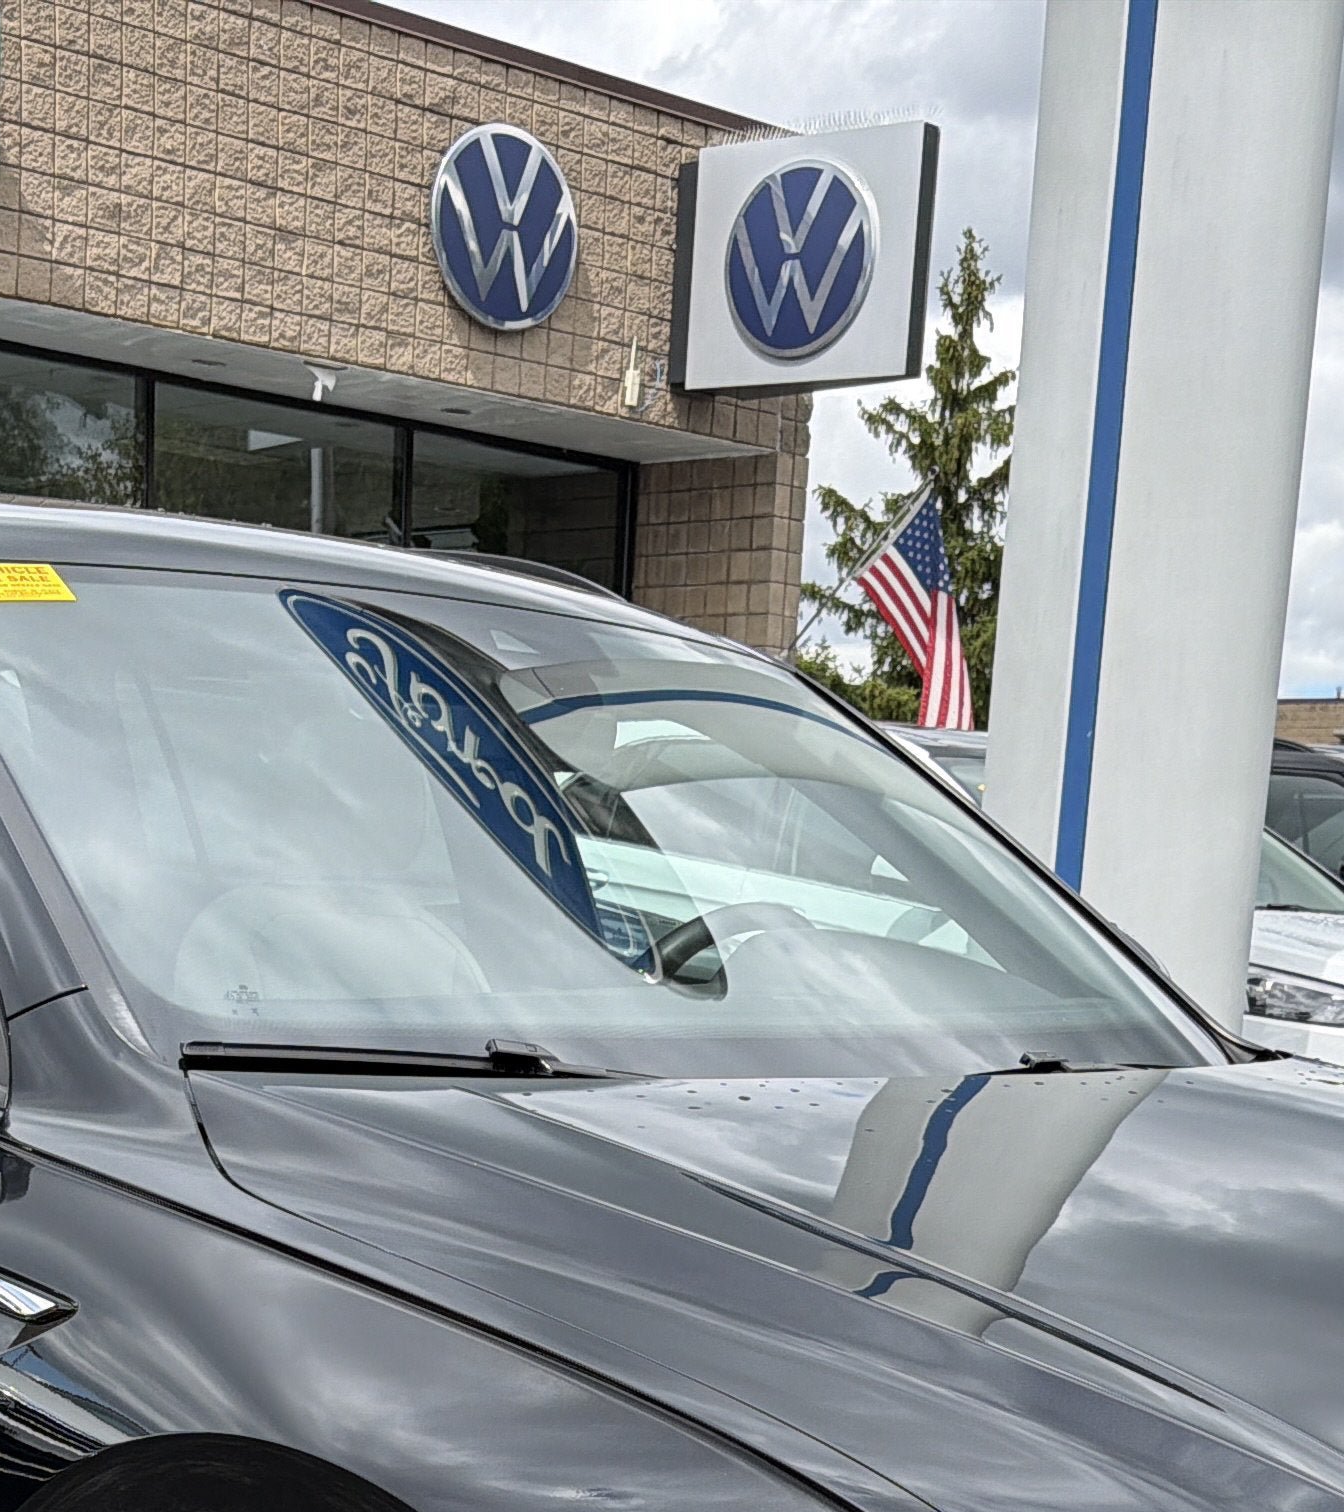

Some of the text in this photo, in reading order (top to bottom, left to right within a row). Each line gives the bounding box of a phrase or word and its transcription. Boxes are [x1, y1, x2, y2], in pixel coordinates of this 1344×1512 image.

[436, 130, 575, 315] VW
[734, 166, 866, 337] VW
[8, 574, 51, 584] SALE
